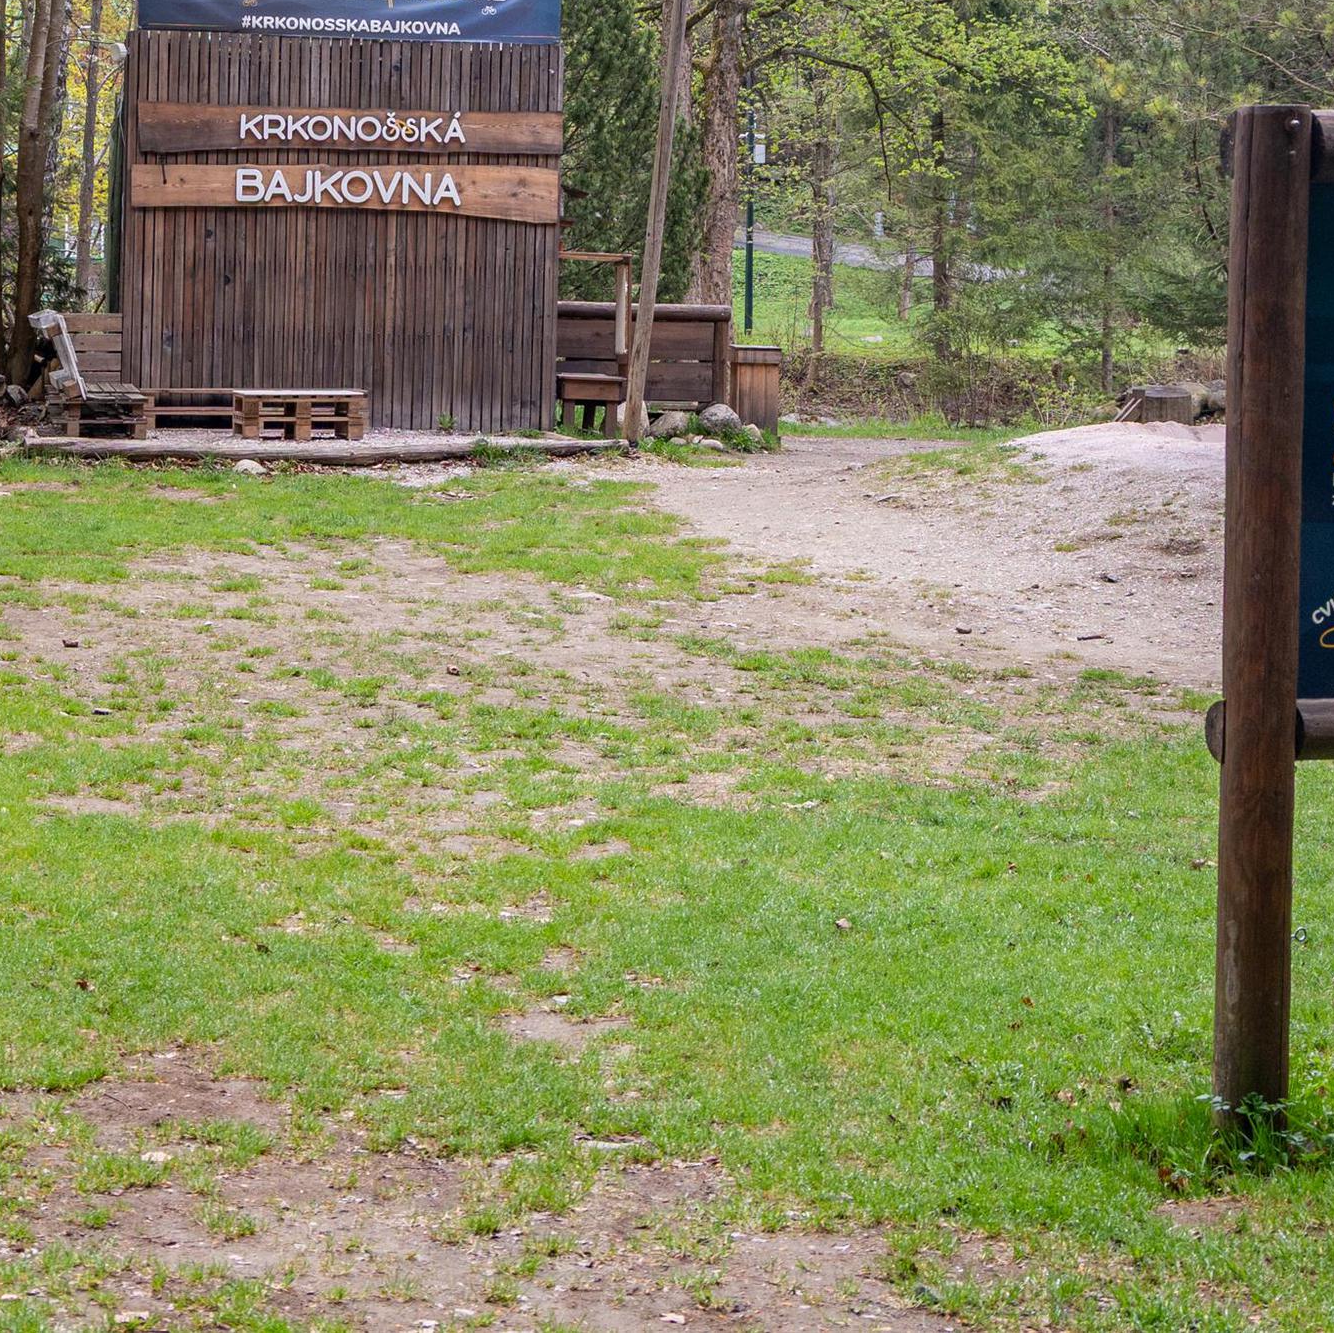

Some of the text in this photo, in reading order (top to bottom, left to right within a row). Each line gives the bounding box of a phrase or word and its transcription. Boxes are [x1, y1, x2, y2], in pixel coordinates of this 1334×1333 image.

[241, 15, 460, 36] #KRKONOSSKABAJKOVNA
[239, 111, 466, 144] KRKONOŠSKÁ
[235, 168, 461, 206] BAJKOVNA
